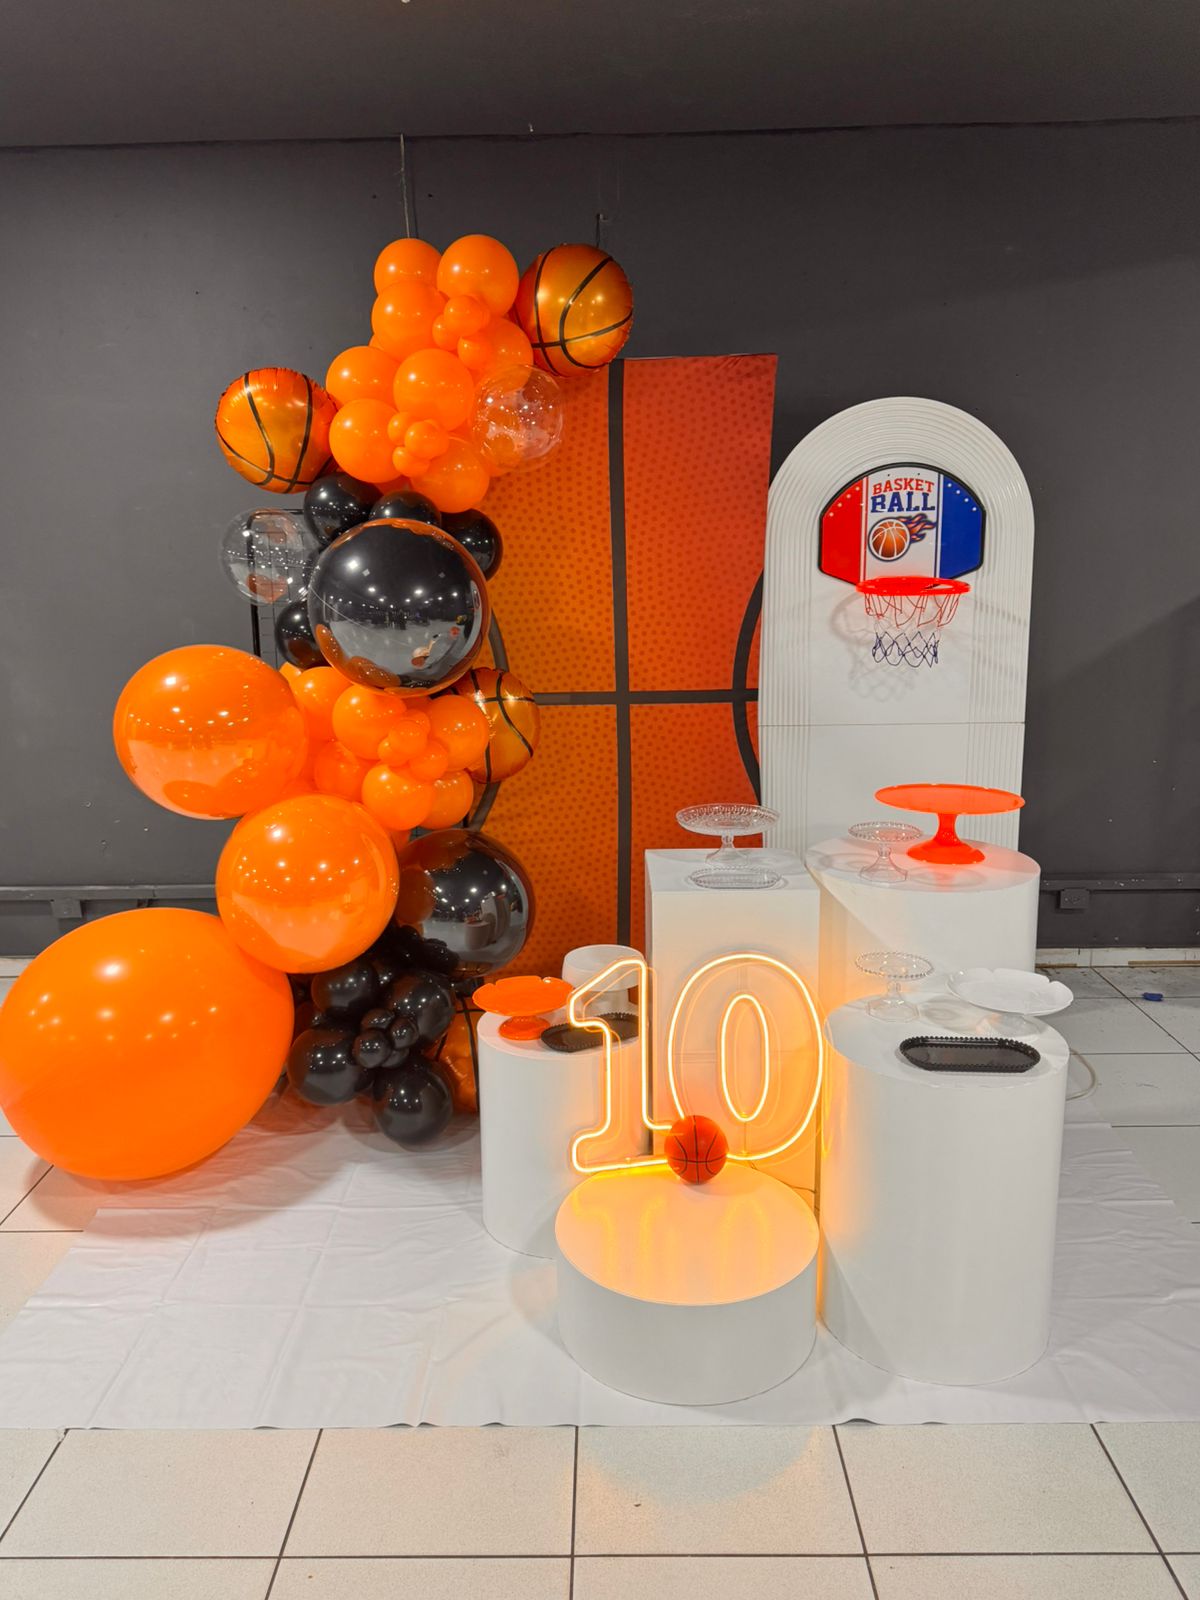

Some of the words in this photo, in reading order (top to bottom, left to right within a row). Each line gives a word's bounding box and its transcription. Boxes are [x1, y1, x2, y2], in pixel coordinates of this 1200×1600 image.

[873, 478, 935, 495] BASKET
[871, 491, 936, 513] BALL
[568, 953, 824, 1173] 10
